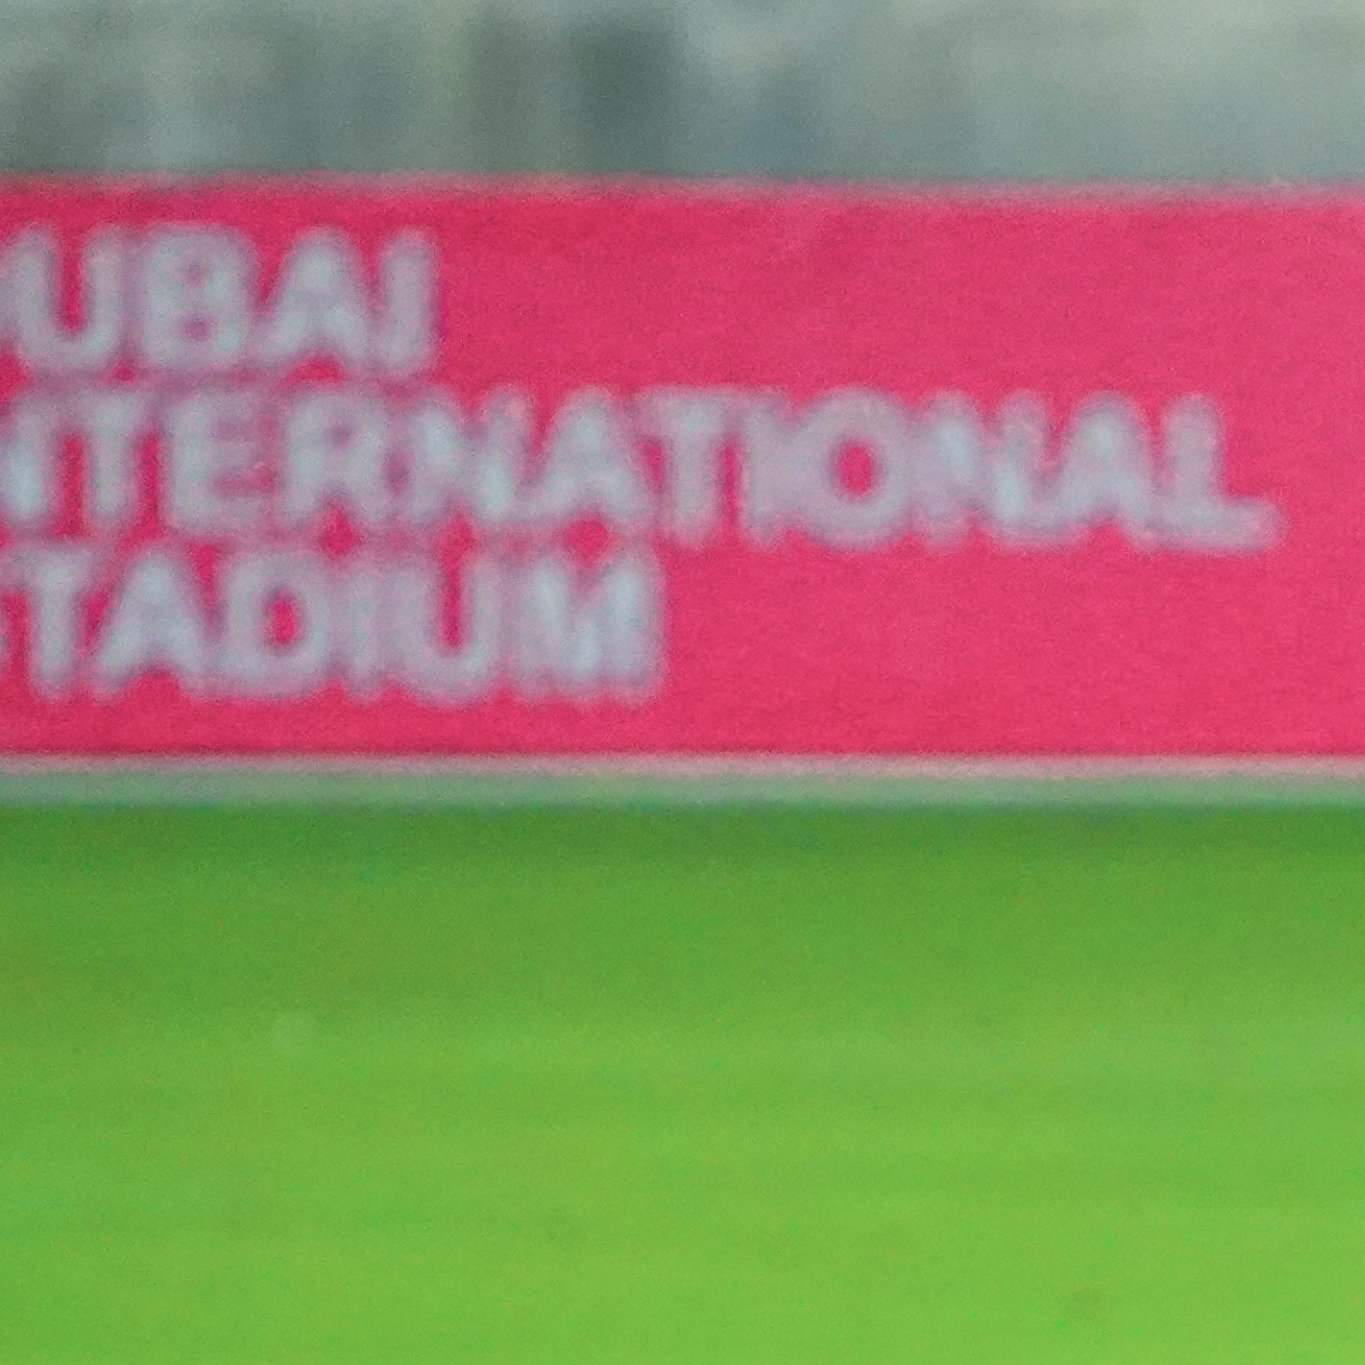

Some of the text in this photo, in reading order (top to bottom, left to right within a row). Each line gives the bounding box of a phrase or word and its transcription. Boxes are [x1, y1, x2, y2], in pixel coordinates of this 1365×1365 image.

[0, 222, 438, 376] UBAI
[0, 390, 1278, 555] NTERNATIONAL
[0, 550, 668, 706] TADIUM
